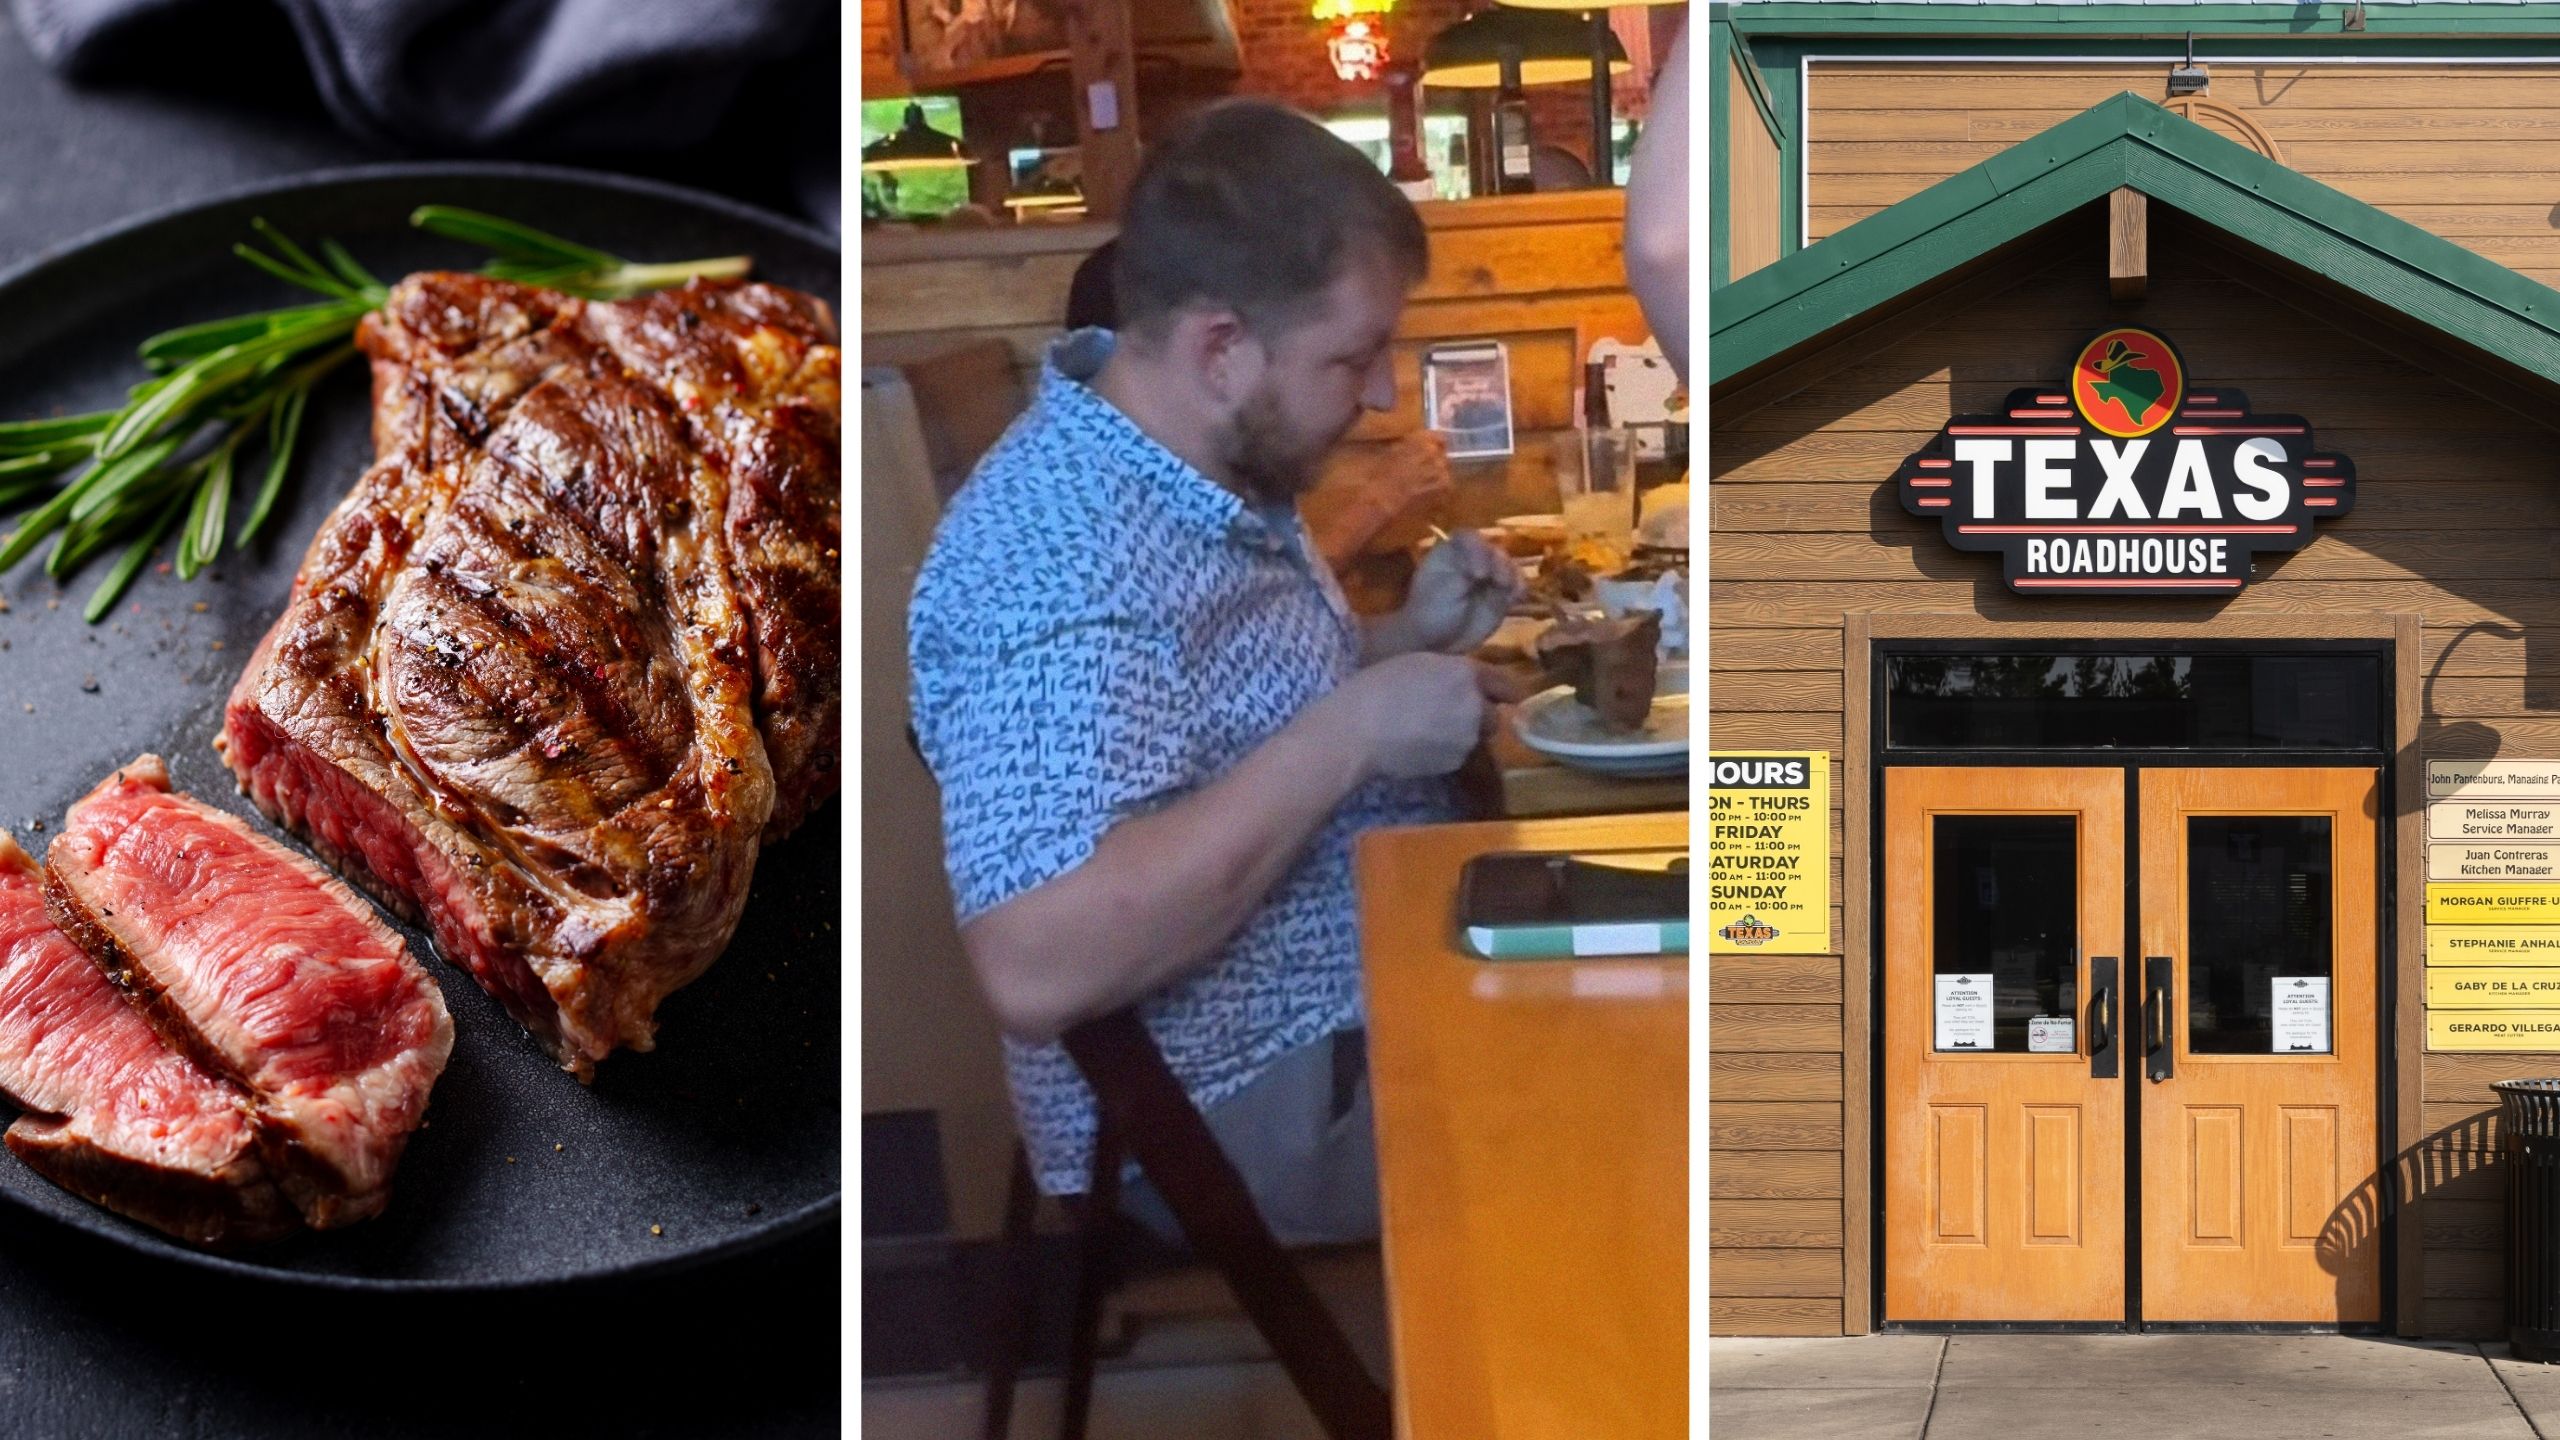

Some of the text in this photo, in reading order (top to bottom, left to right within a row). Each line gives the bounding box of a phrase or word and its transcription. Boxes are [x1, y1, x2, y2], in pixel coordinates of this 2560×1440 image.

[1954, 437, 2291, 521] TEXAS
[2027, 538, 2227, 575] ROADHOUSE
[2431, 774, 2451, 784] John
[2507, 774, 2549, 785] Managing
[1749, 796, 1810, 810] THURS
[1754, 812, 1786, 821] 10:00
[2466, 809, 2550, 821] Melissa Murray
[1715, 825, 1783, 839] FRIDAY
[2462, 824, 2553, 834] Service Manager
[1755, 842, 1785, 850] 11:00
[2465, 850, 2548, 860] Juan Contreras
[1709, 856, 1800, 869] ATURDAY
[2461, 865, 2553, 875] Kitchen Manager
[1756, 872, 1786, 880] 11:00
[1711, 885, 1787, 899] SUNDAY
[1755, 902, 1788, 910] 10:00
[2440, 897, 2493, 906] MORGAN
[1727, 927, 1772, 939] TEXAS
[2449, 939, 2516, 948] STEPHANIE
[2455, 982, 2488, 991] GABY
[2492, 982, 2508, 991] DE
[2512, 982, 2528, 991] LA
[2449, 1024, 2560, 1032] GERARDO VILLEGA
